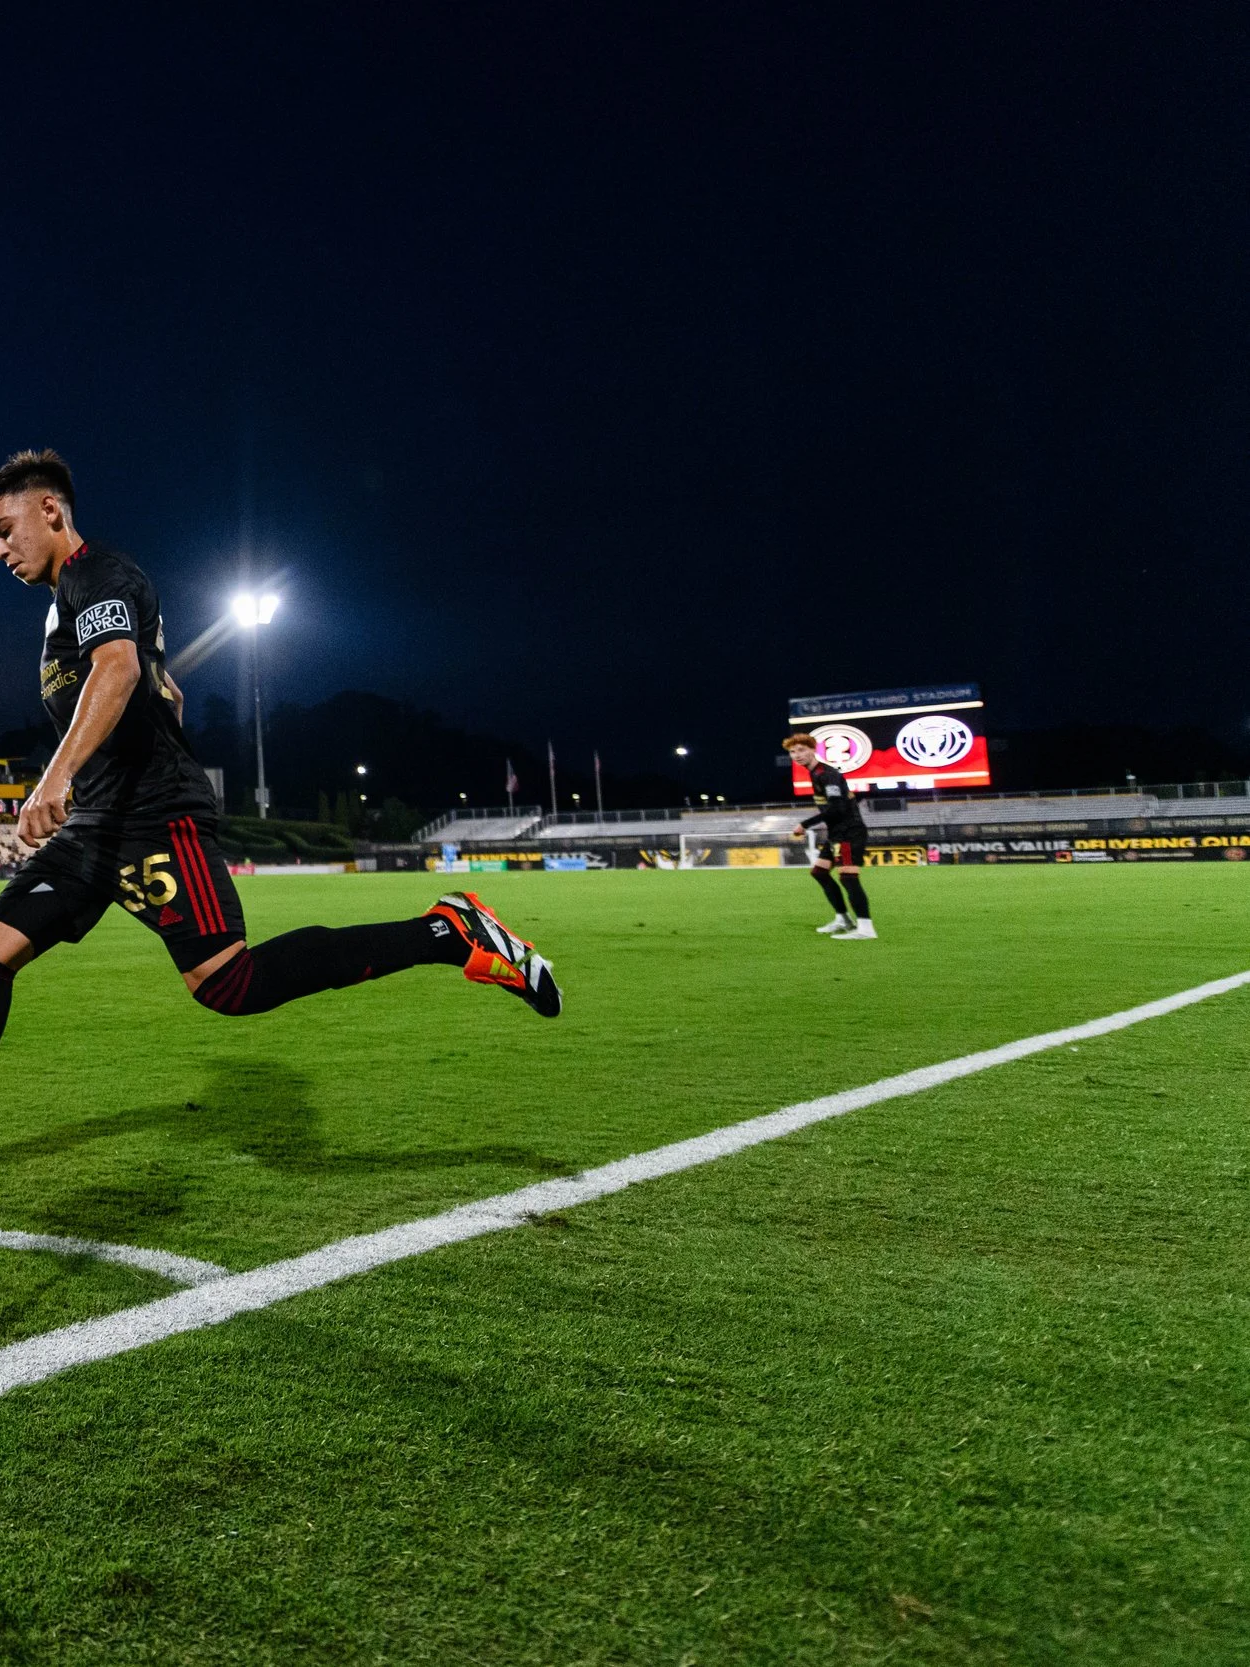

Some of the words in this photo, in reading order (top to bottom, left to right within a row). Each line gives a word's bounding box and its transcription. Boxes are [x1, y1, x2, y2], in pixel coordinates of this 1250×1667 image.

[85, 603, 122, 626] NEXT
[92, 614, 127, 632] PRO
[911, 689, 972, 702] STADIUM
[928, 842, 1006, 854] DRIVING
[119, 853, 178, 913] 55
